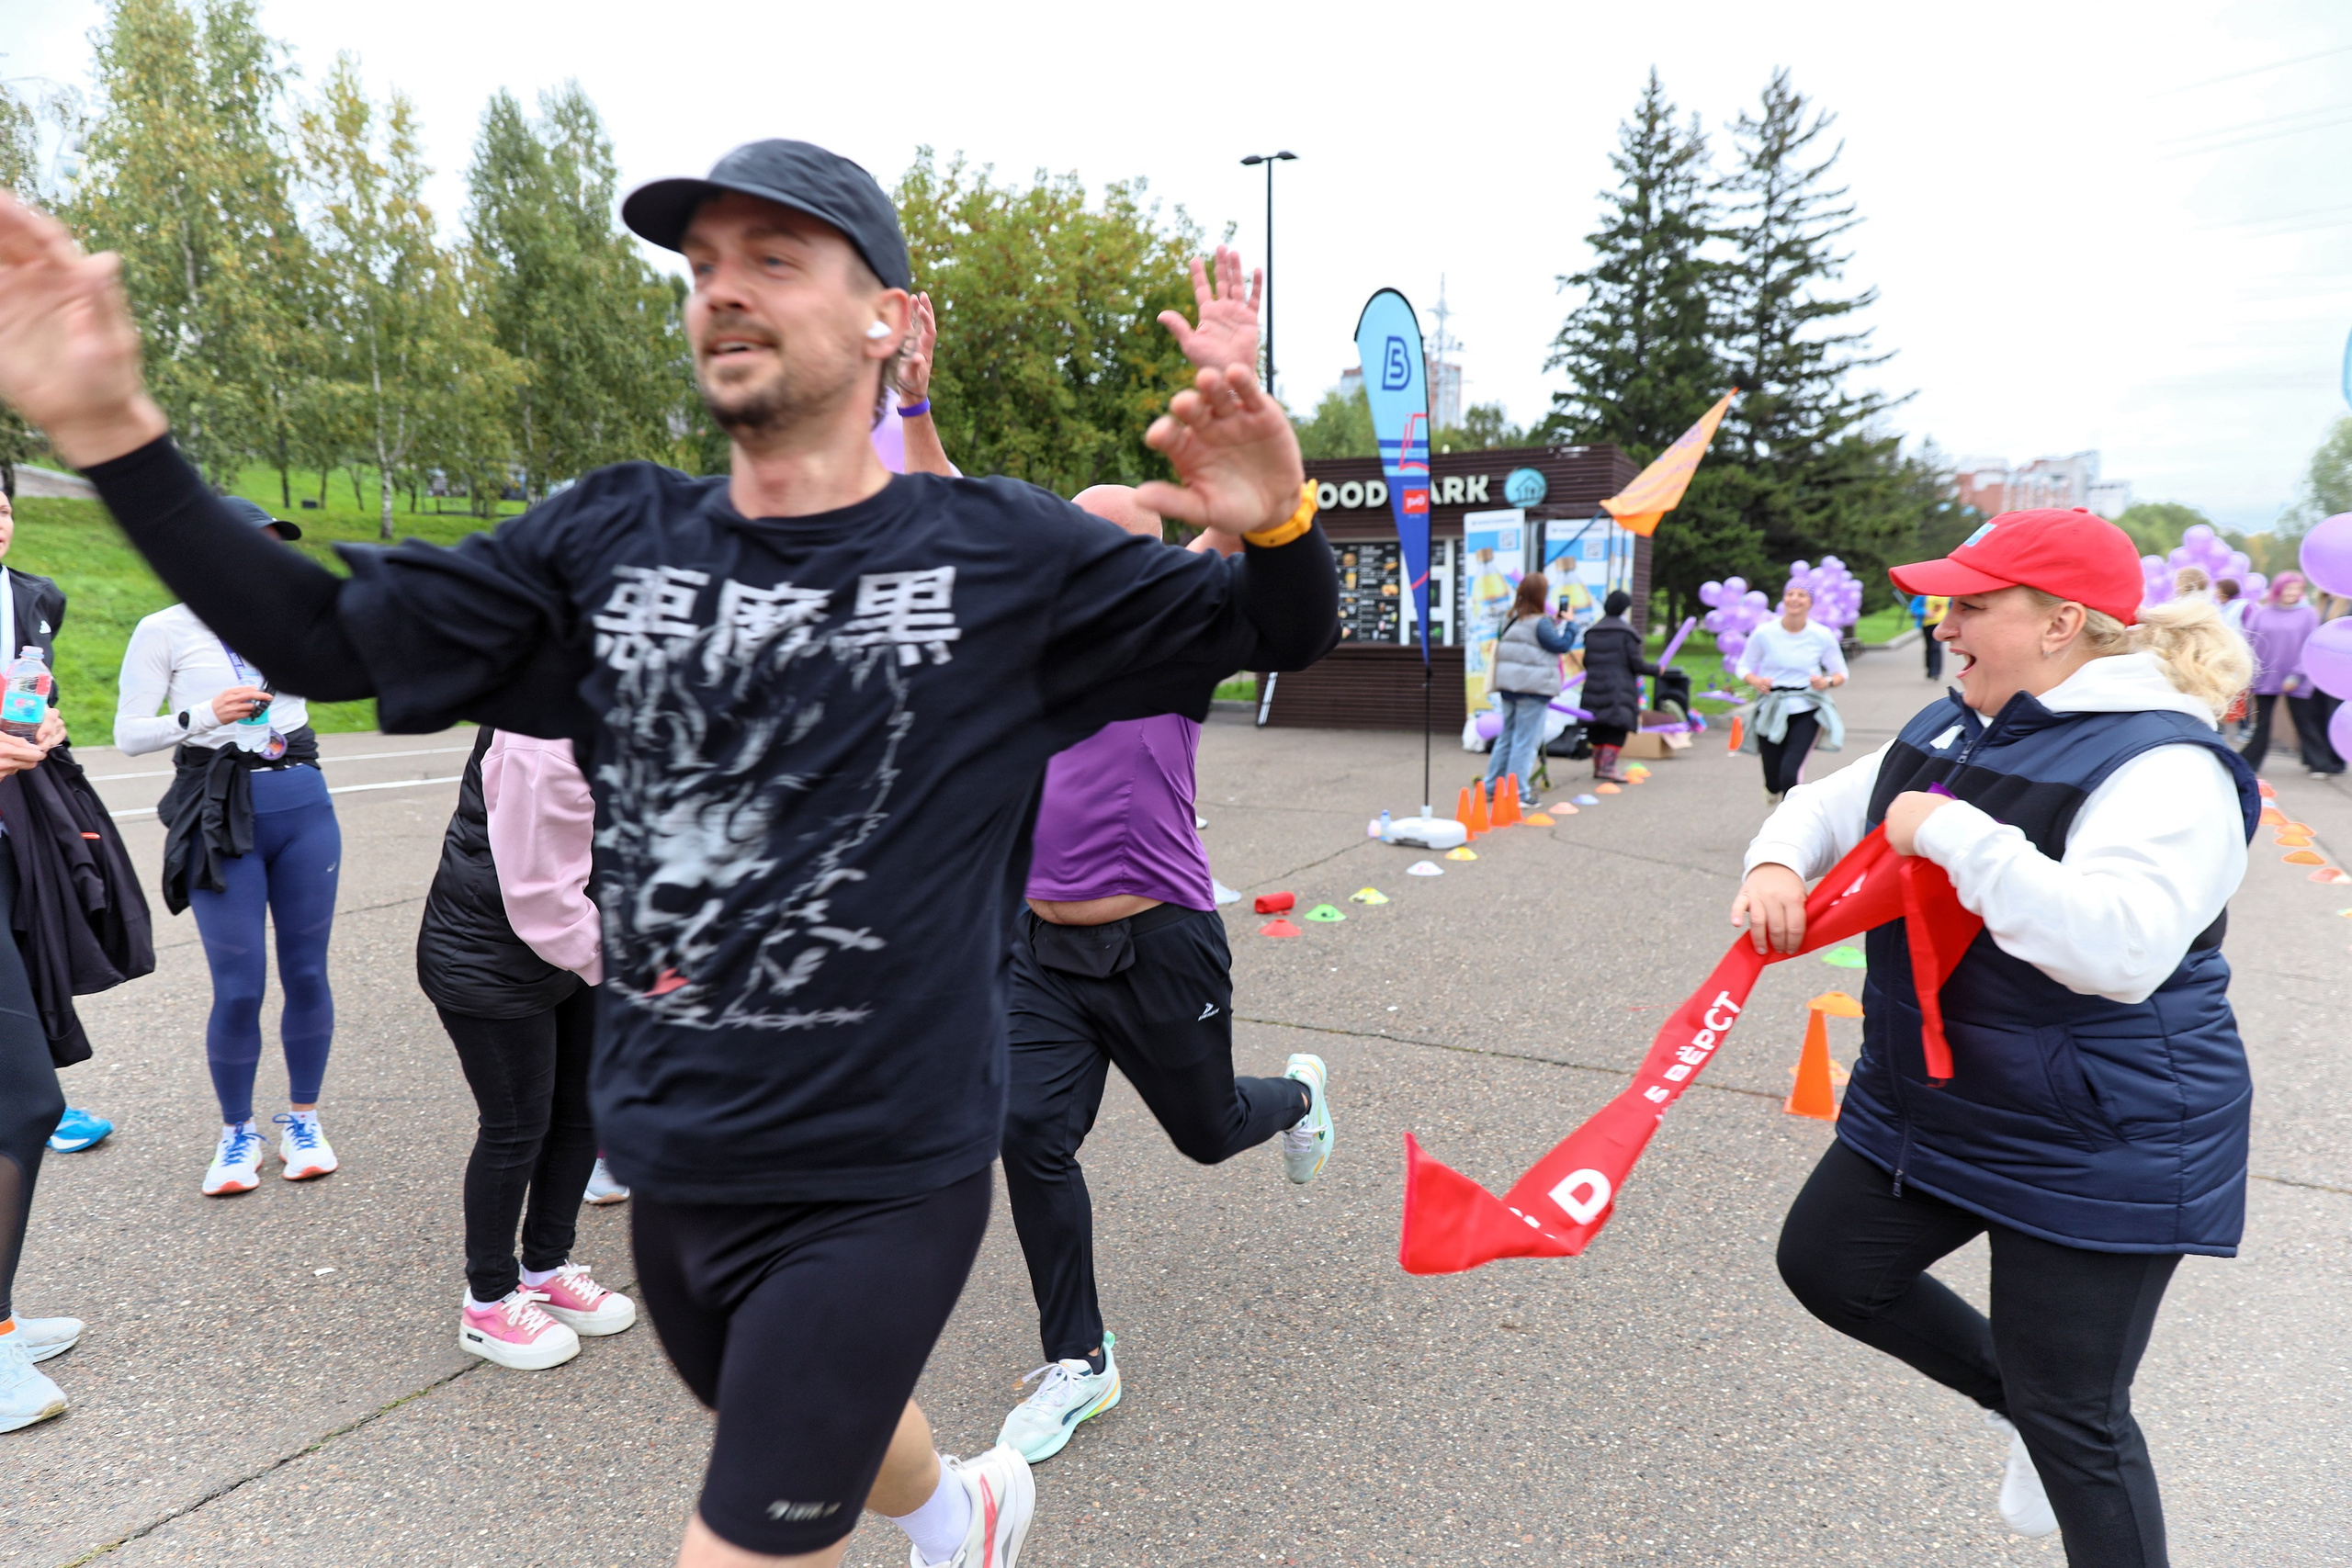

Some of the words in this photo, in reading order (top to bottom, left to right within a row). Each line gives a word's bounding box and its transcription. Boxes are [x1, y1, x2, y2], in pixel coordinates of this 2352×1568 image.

[1317, 480, 1388, 509] OOD
[1430, 474, 1490, 505] RK
[1643, 1085, 1670, 1103] 5
[1663, 990, 1742, 1082] ВЁРСТ
